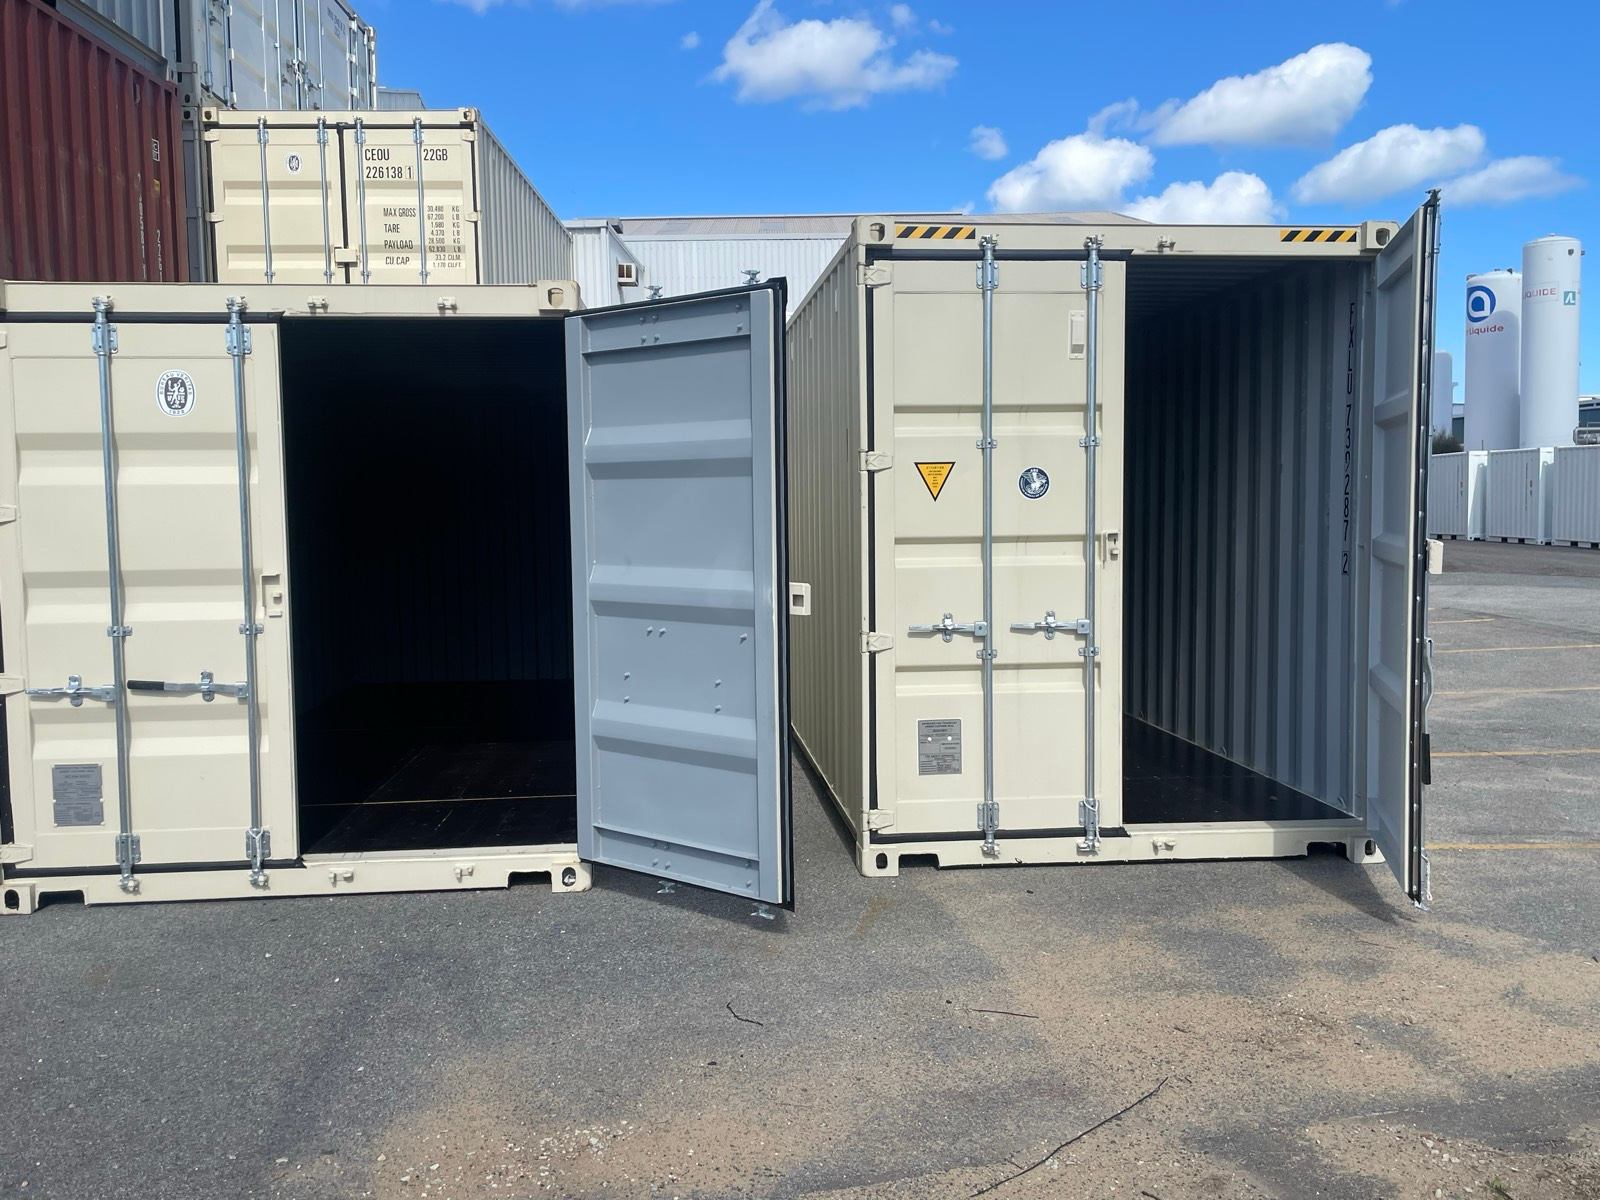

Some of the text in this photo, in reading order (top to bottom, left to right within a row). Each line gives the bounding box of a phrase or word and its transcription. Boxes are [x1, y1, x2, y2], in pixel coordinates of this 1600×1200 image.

[365, 148, 390, 161] CEOU
[423, 148, 448, 161] 22GB
[366, 166, 403, 179] 226138
[383, 207, 416, 218] MAX GROSS
[384, 223, 400, 233] TARE
[384, 240, 414, 250] PAYLOAD
